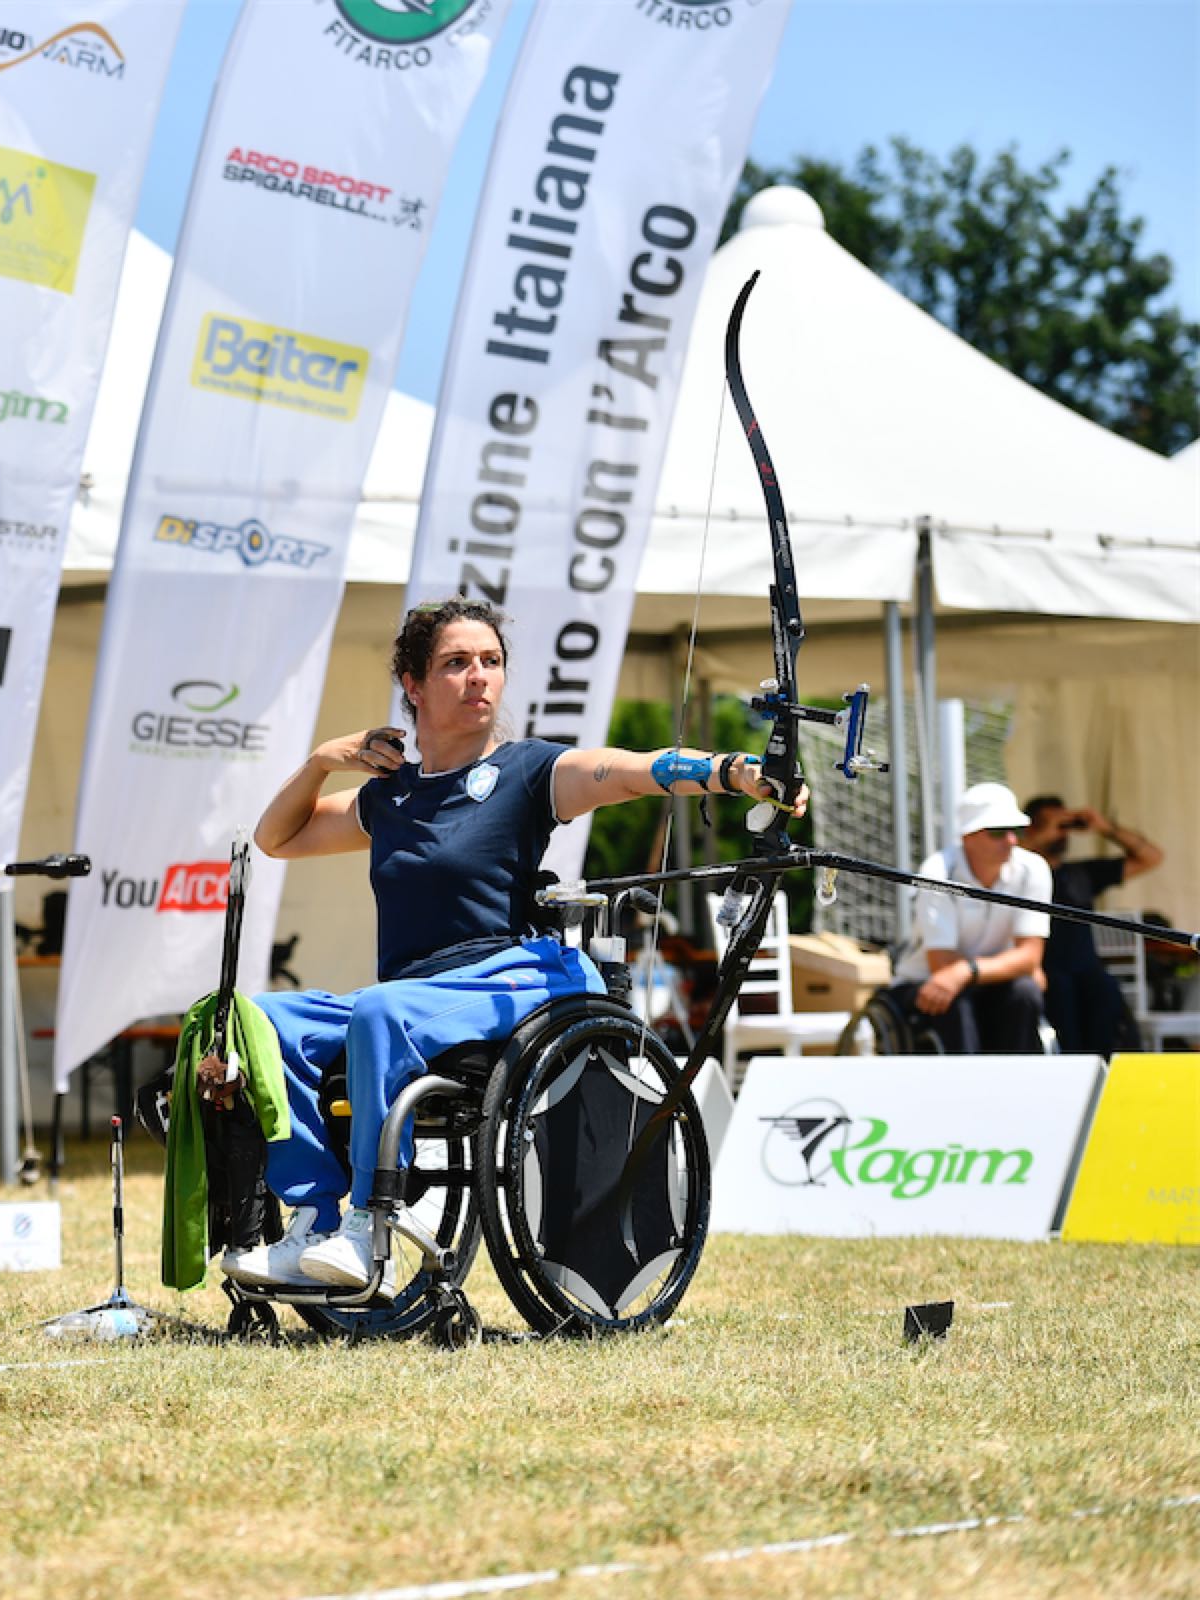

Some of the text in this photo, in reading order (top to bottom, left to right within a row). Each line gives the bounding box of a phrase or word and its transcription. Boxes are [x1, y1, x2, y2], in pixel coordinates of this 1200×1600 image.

[322, 19, 432, 71] FITARCO
[223, 164, 366, 215] SPIGARELLI
[227, 147, 392, 203] ARCO SPORT
[485, 64, 622, 365] Italiana
[202, 317, 360, 393] Beiter
[567, 459, 639, 594] con
[131, 711, 271, 750] GIESSE
[101, 869, 159, 909] You
[829, 1115, 1035, 1201] Ragim
